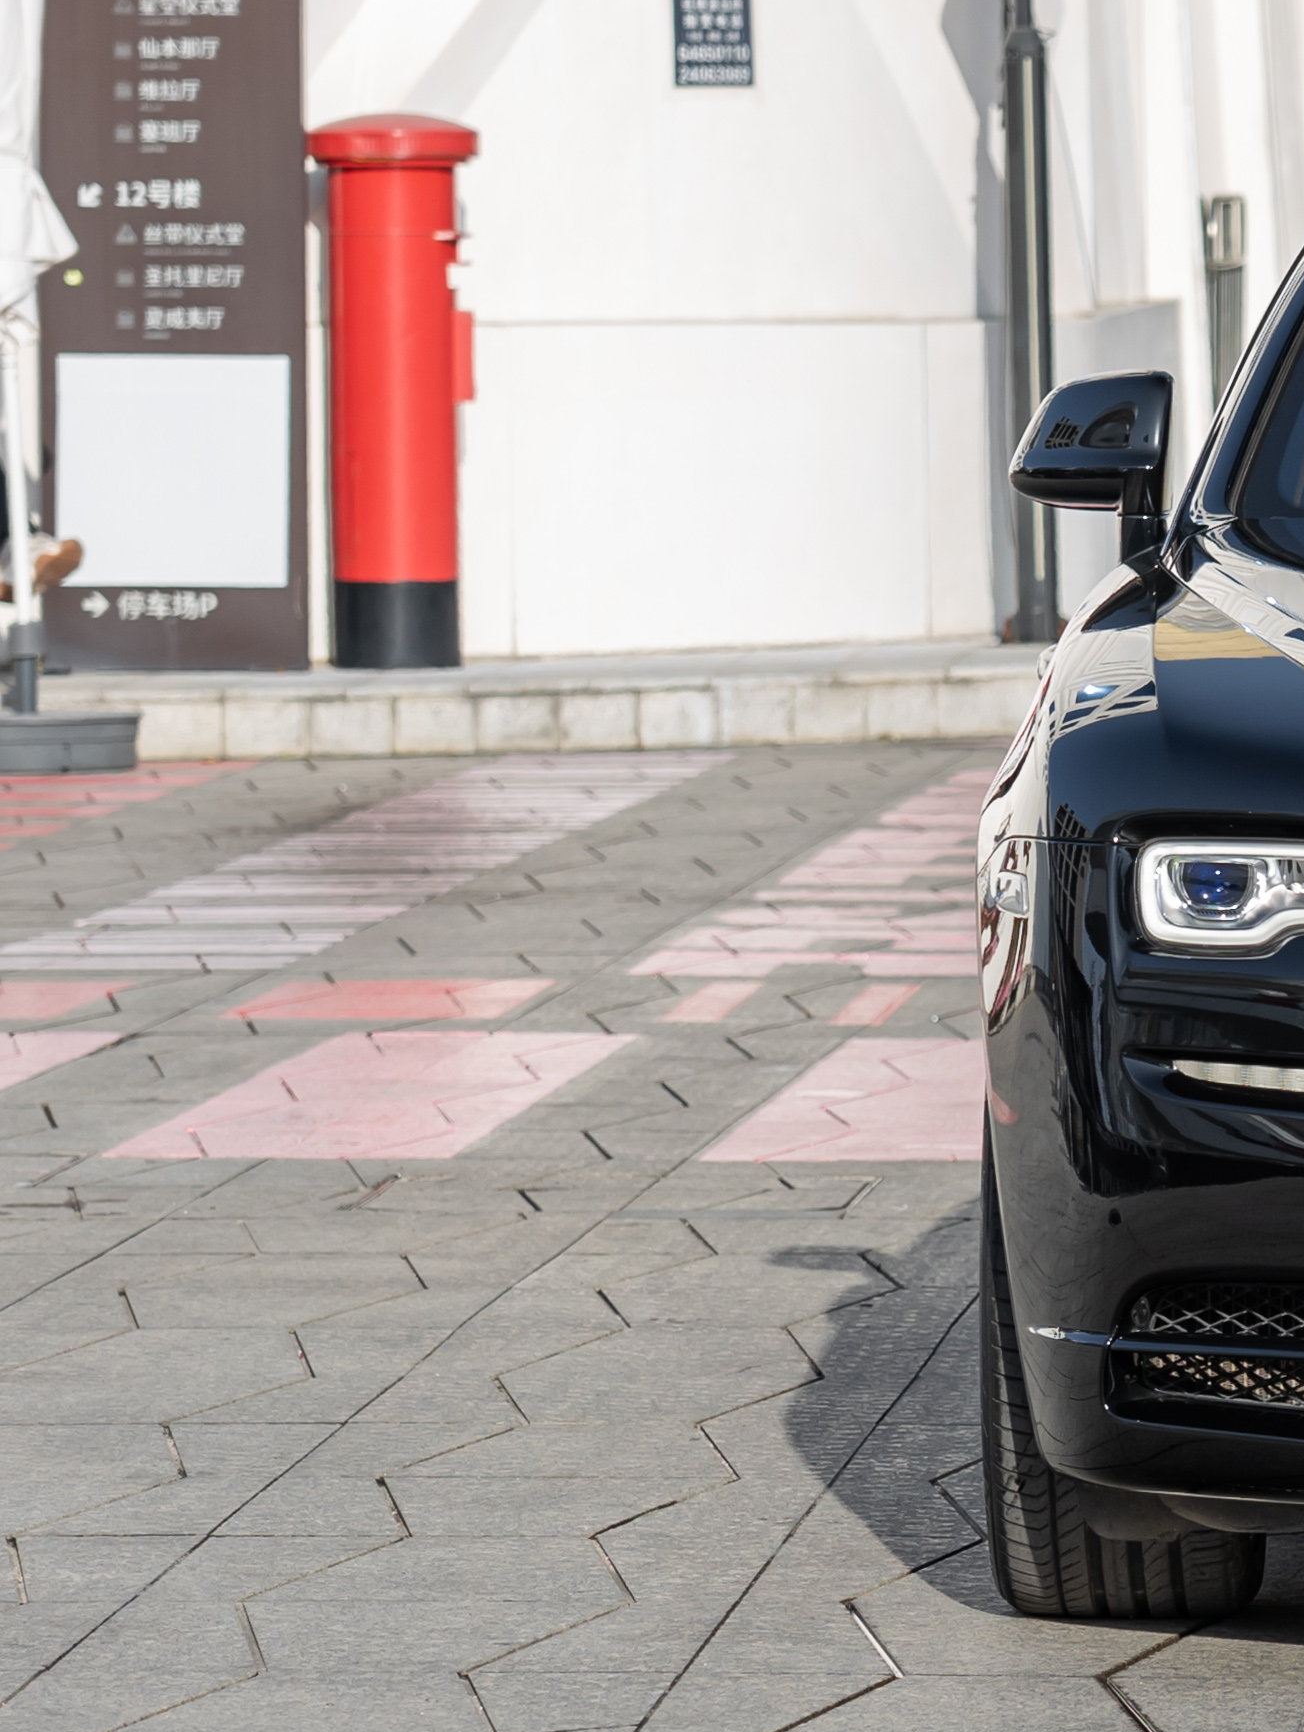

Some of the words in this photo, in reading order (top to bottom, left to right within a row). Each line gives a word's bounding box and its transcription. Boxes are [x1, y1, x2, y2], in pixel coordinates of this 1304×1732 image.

[114, 178, 201, 209] 12号楼
[143, 222, 245, 246] 丝带仪式堂
